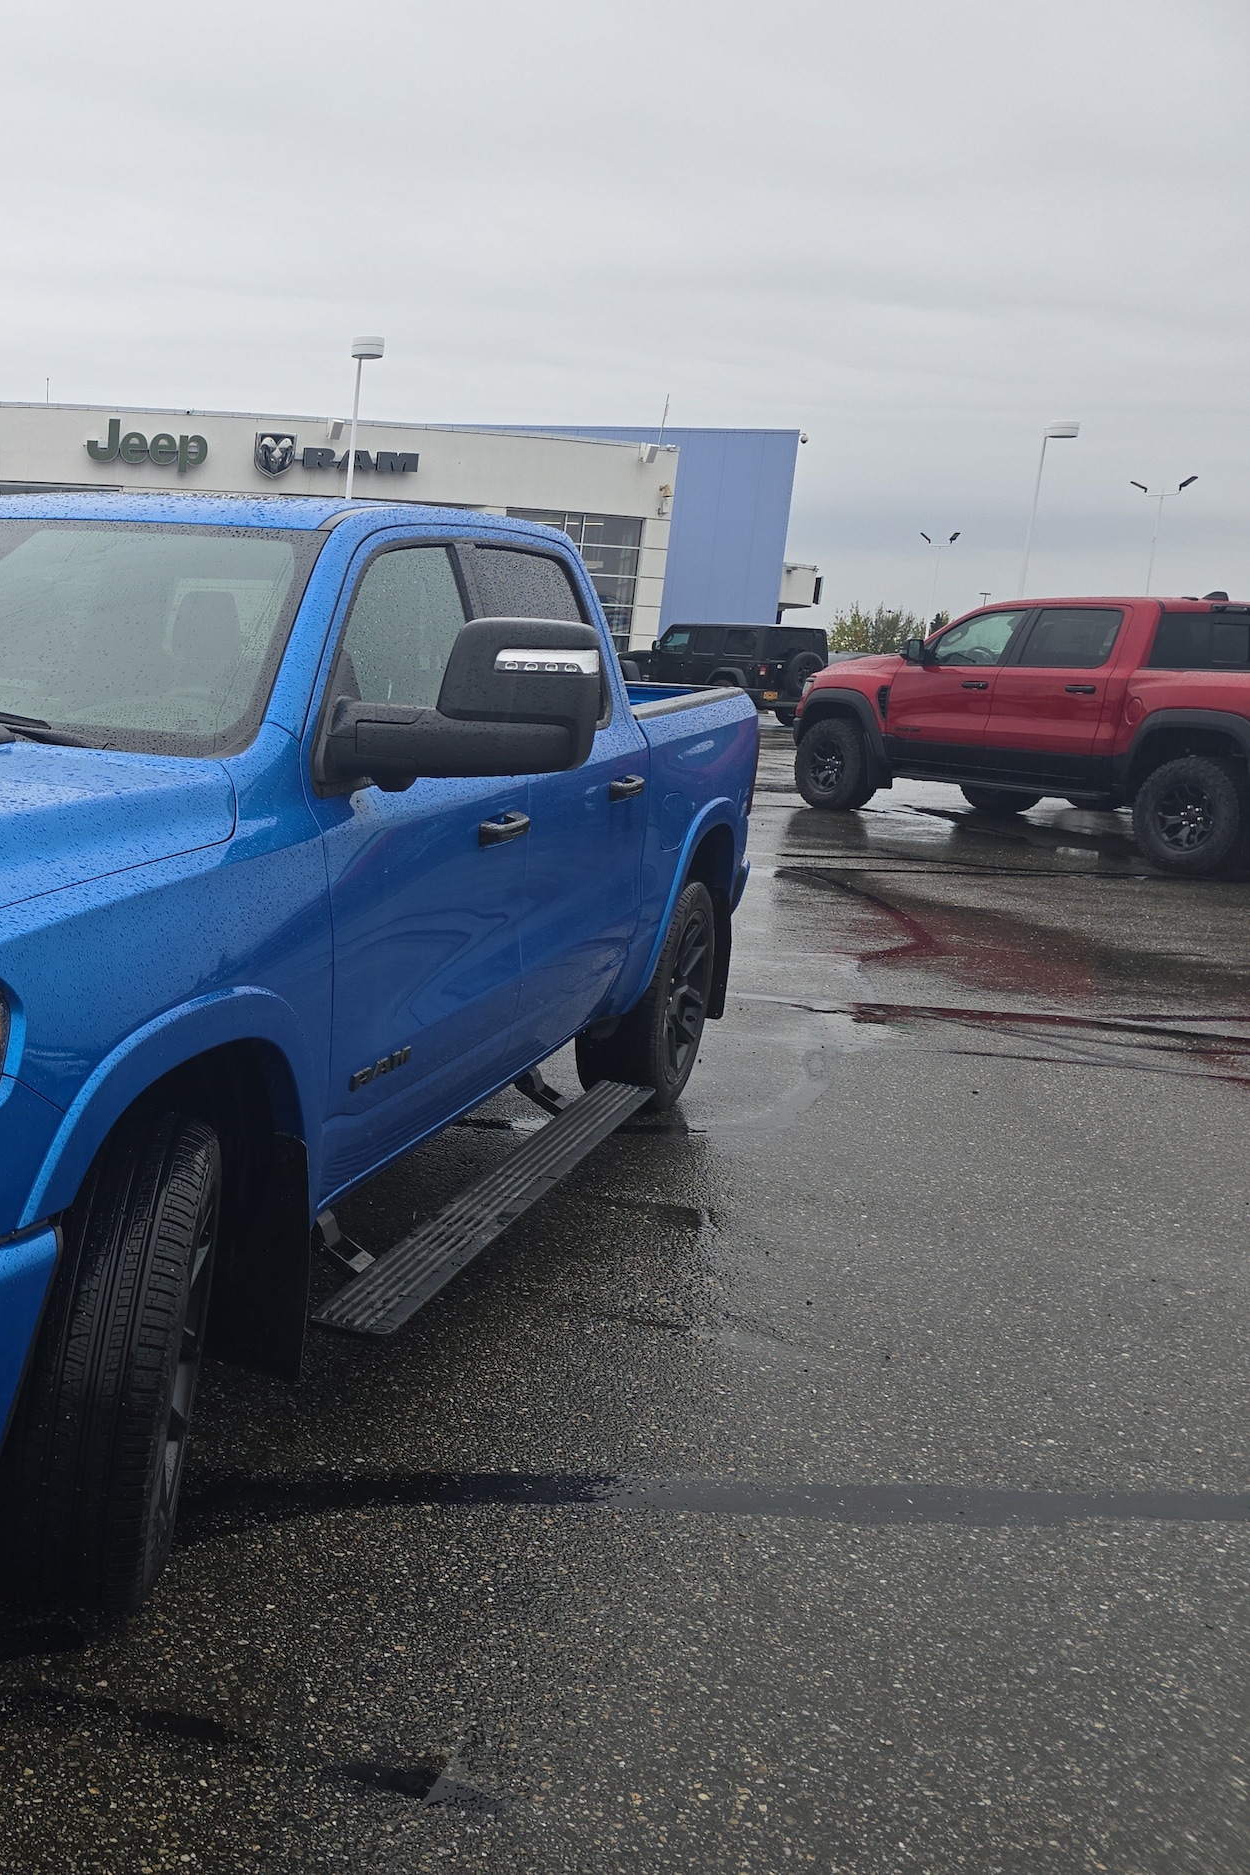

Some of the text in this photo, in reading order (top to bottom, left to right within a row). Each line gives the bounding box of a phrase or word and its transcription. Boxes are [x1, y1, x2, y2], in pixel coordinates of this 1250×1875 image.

[87, 418, 209, 473] Jeep
[302, 447, 420, 472] RAM
[348, 1045, 411, 1092] RAM
